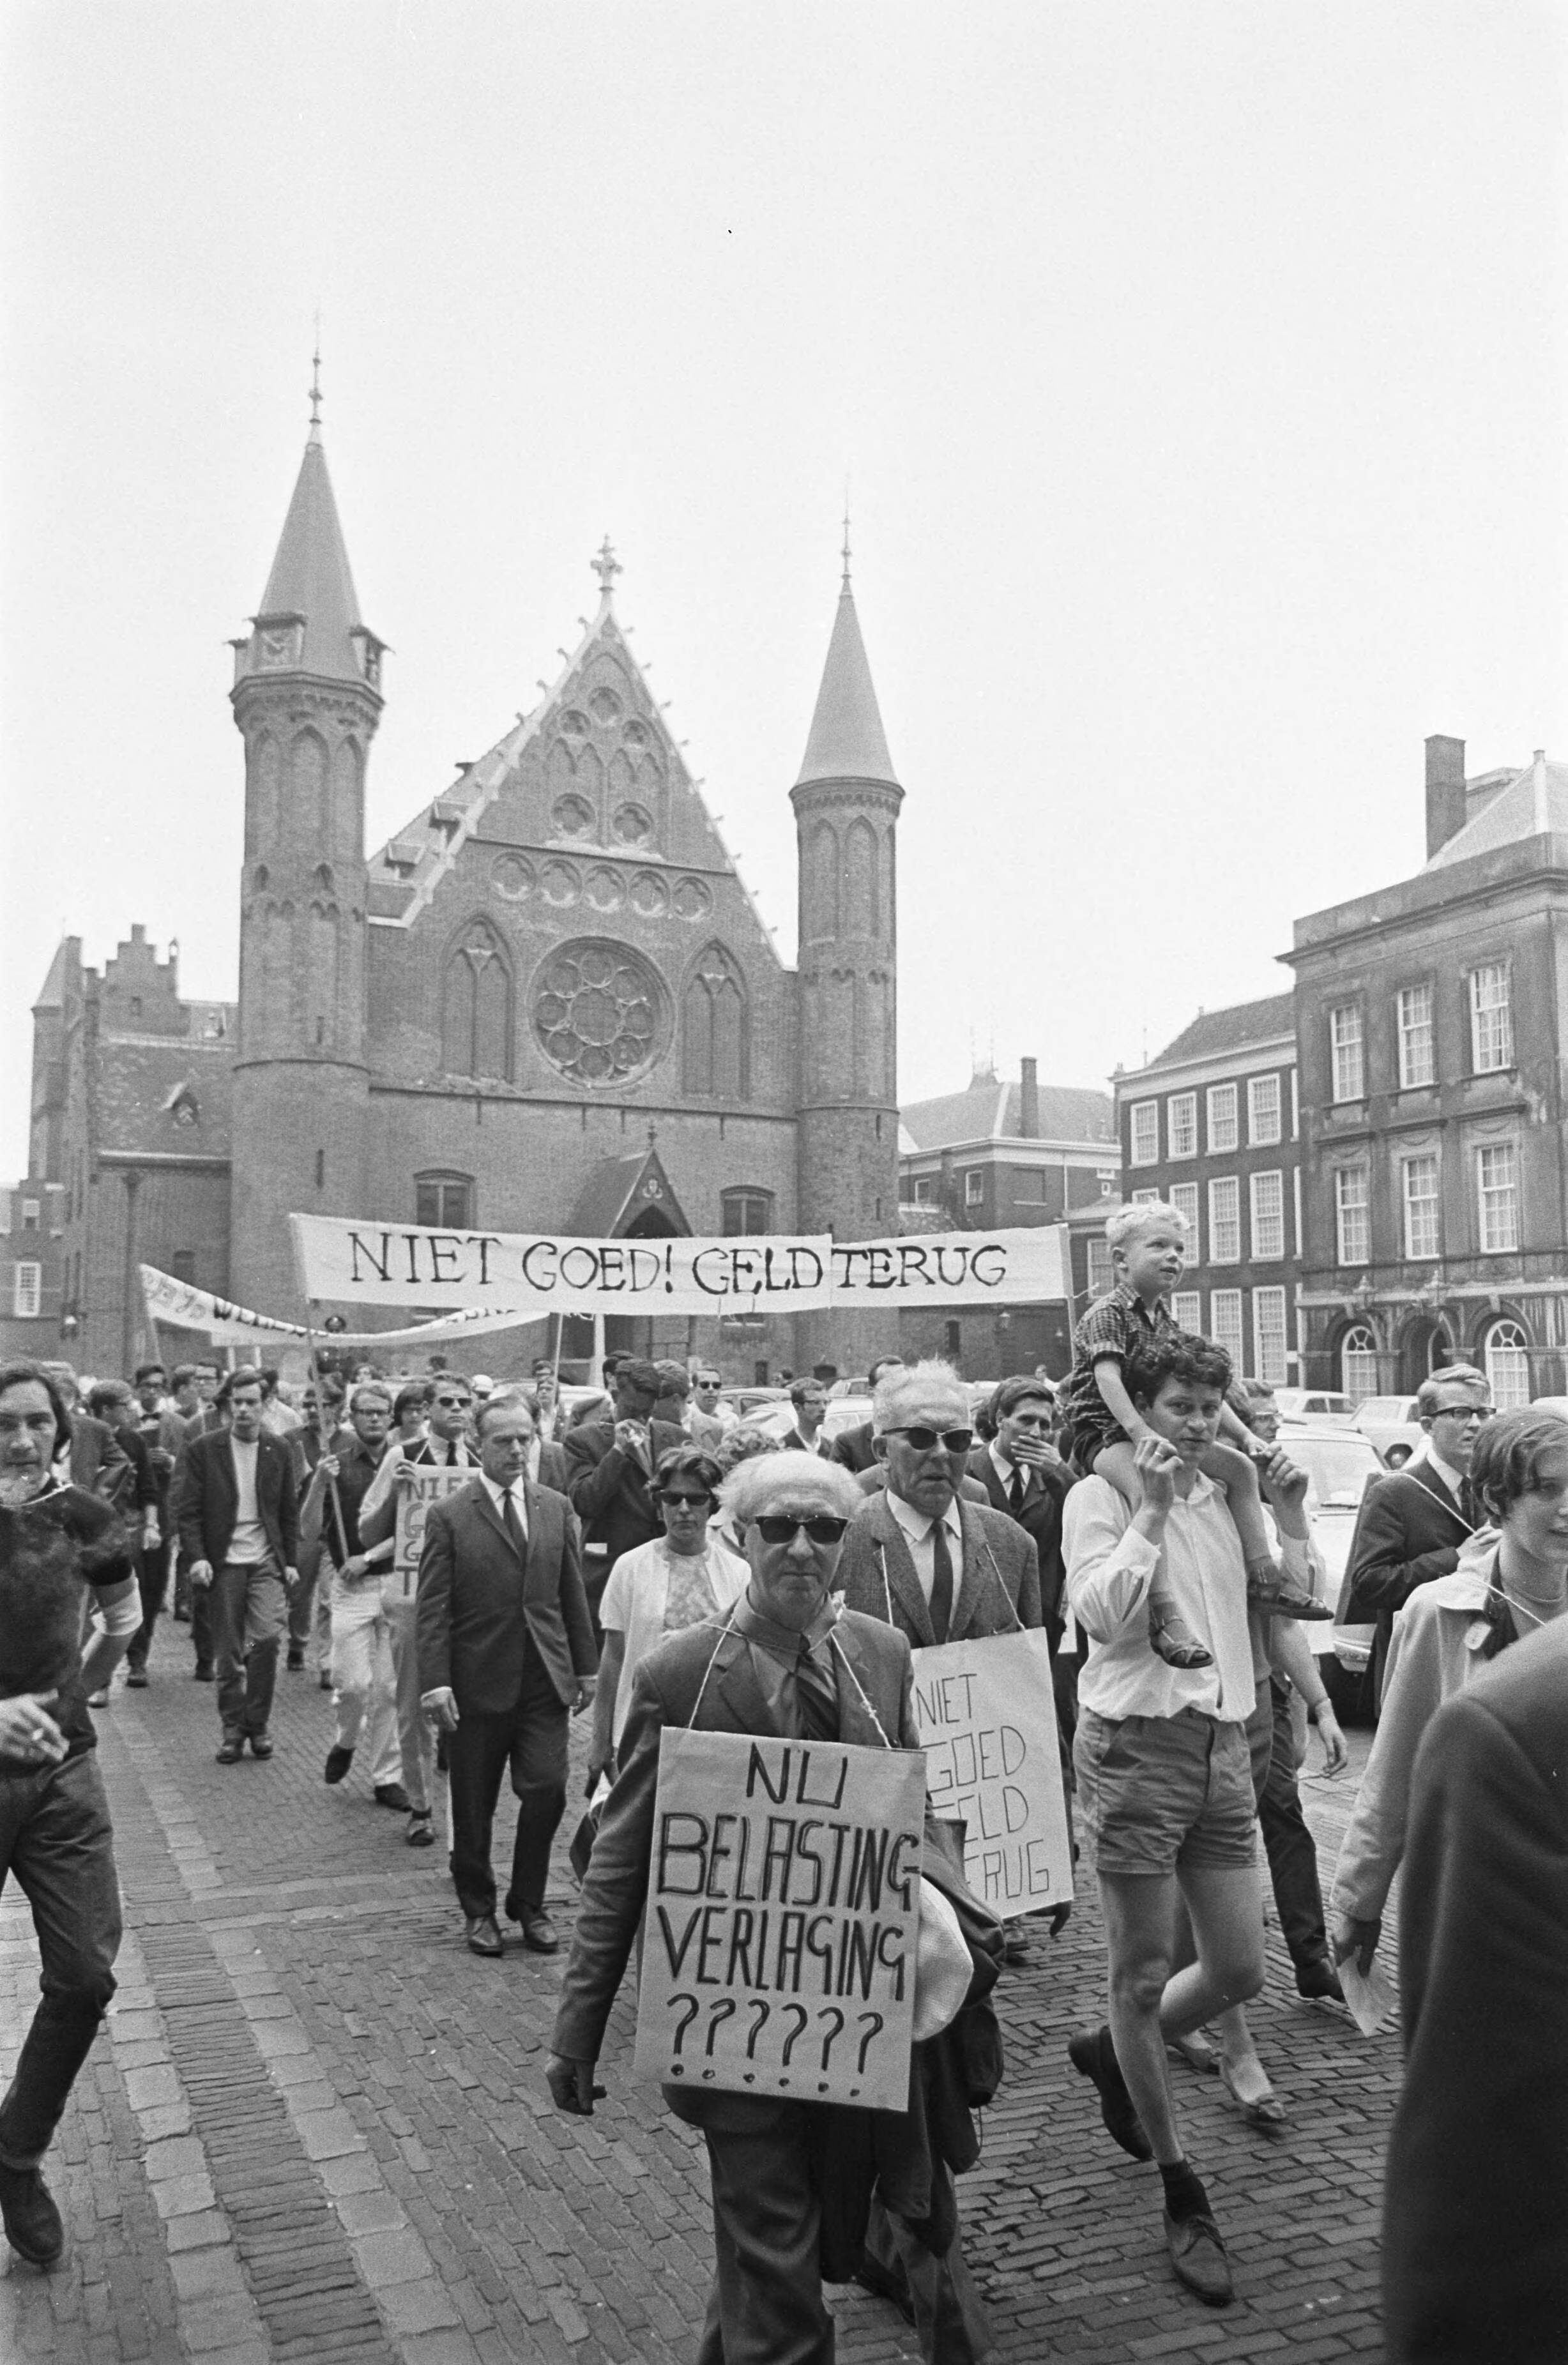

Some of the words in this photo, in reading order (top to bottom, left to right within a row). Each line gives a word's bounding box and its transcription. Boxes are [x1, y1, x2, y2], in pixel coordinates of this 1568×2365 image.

[347, 1232, 502, 1284] NIET
[522, 1241, 673, 1294] GOED!
[692, 1246, 824, 1295] GELD
[831, 1244, 1007, 1289] TERUG
[405, 1476, 481, 1502] NIE
[916, 1673, 977, 1729] NIET
[746, 1742, 848, 1809] NU
[920, 1726, 1026, 1793] GOED
[932, 1786, 1029, 1839] ELD
[657, 1905, 905, 2001] VERLAGING
[666, 1993, 884, 2097] ??????
